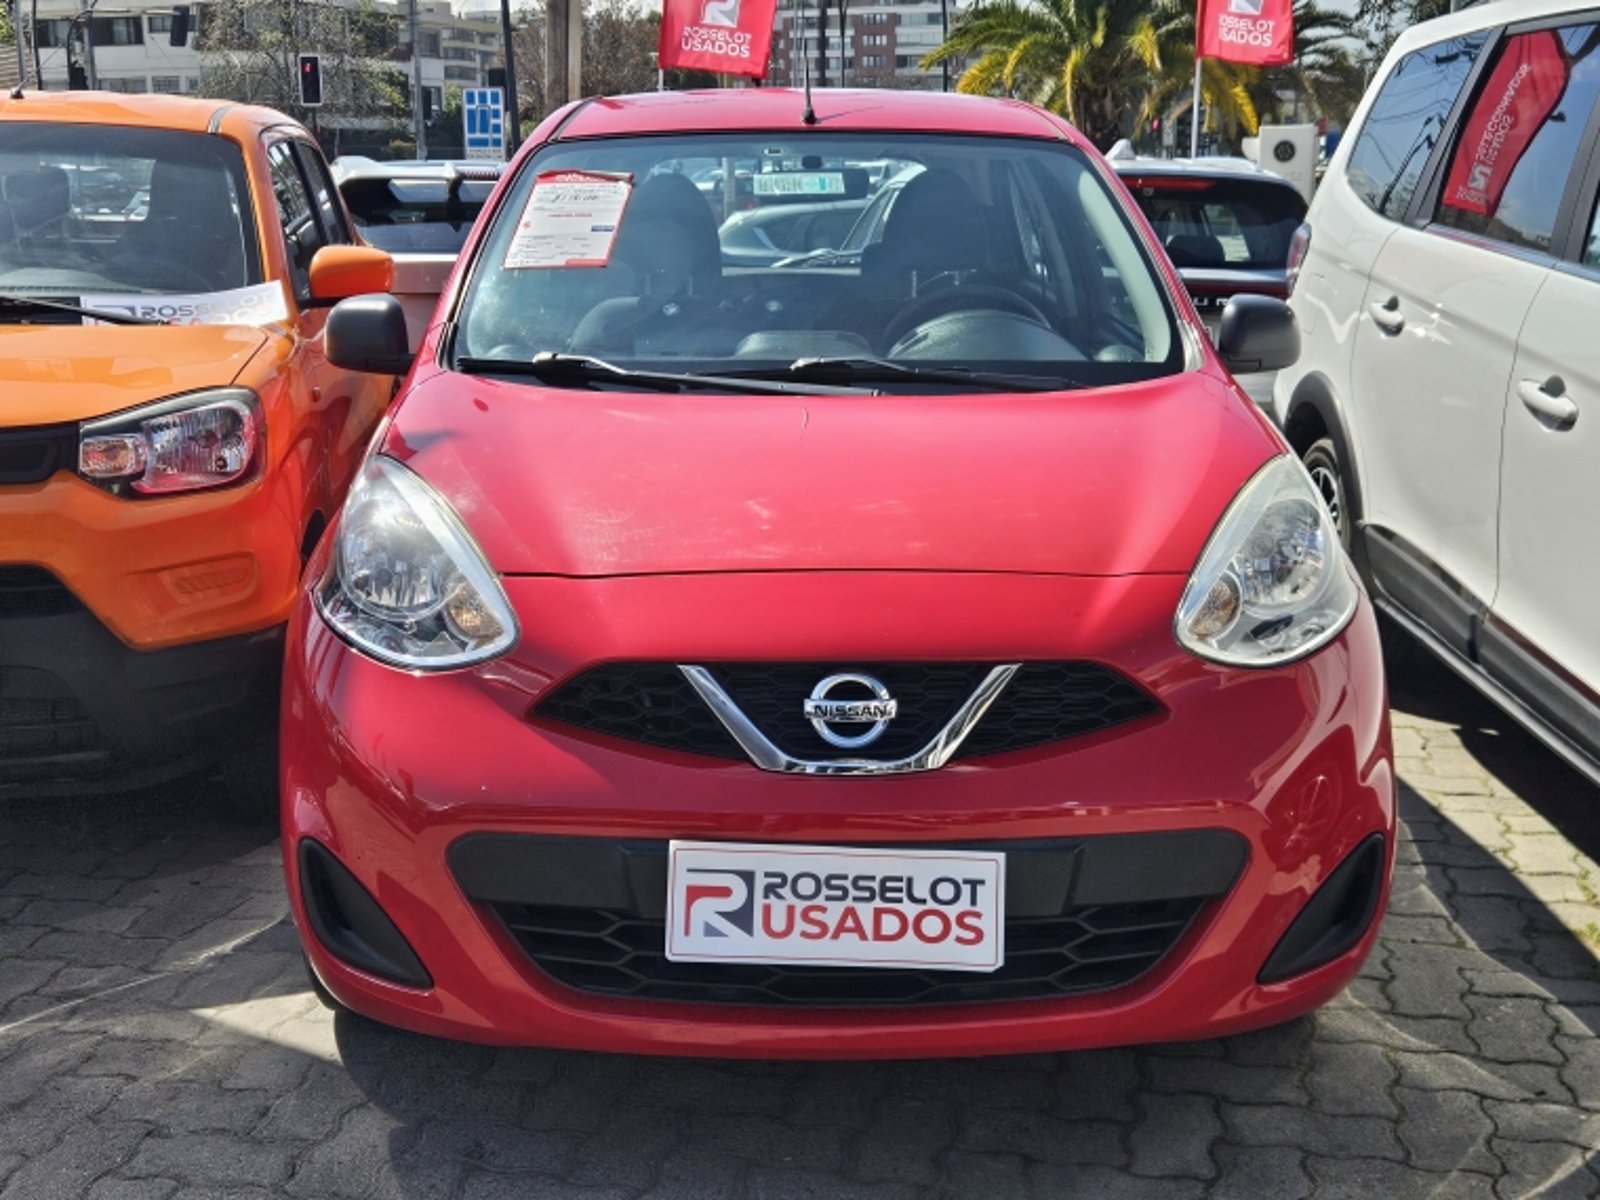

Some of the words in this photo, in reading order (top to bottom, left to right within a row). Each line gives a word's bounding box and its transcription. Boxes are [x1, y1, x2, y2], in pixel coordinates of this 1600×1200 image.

[681, 37, 750, 58] USADOS
[813, 704, 888, 718] NISSAN
[763, 871, 986, 907] ROSSELOT
[761, 903, 985, 946] USADOS
